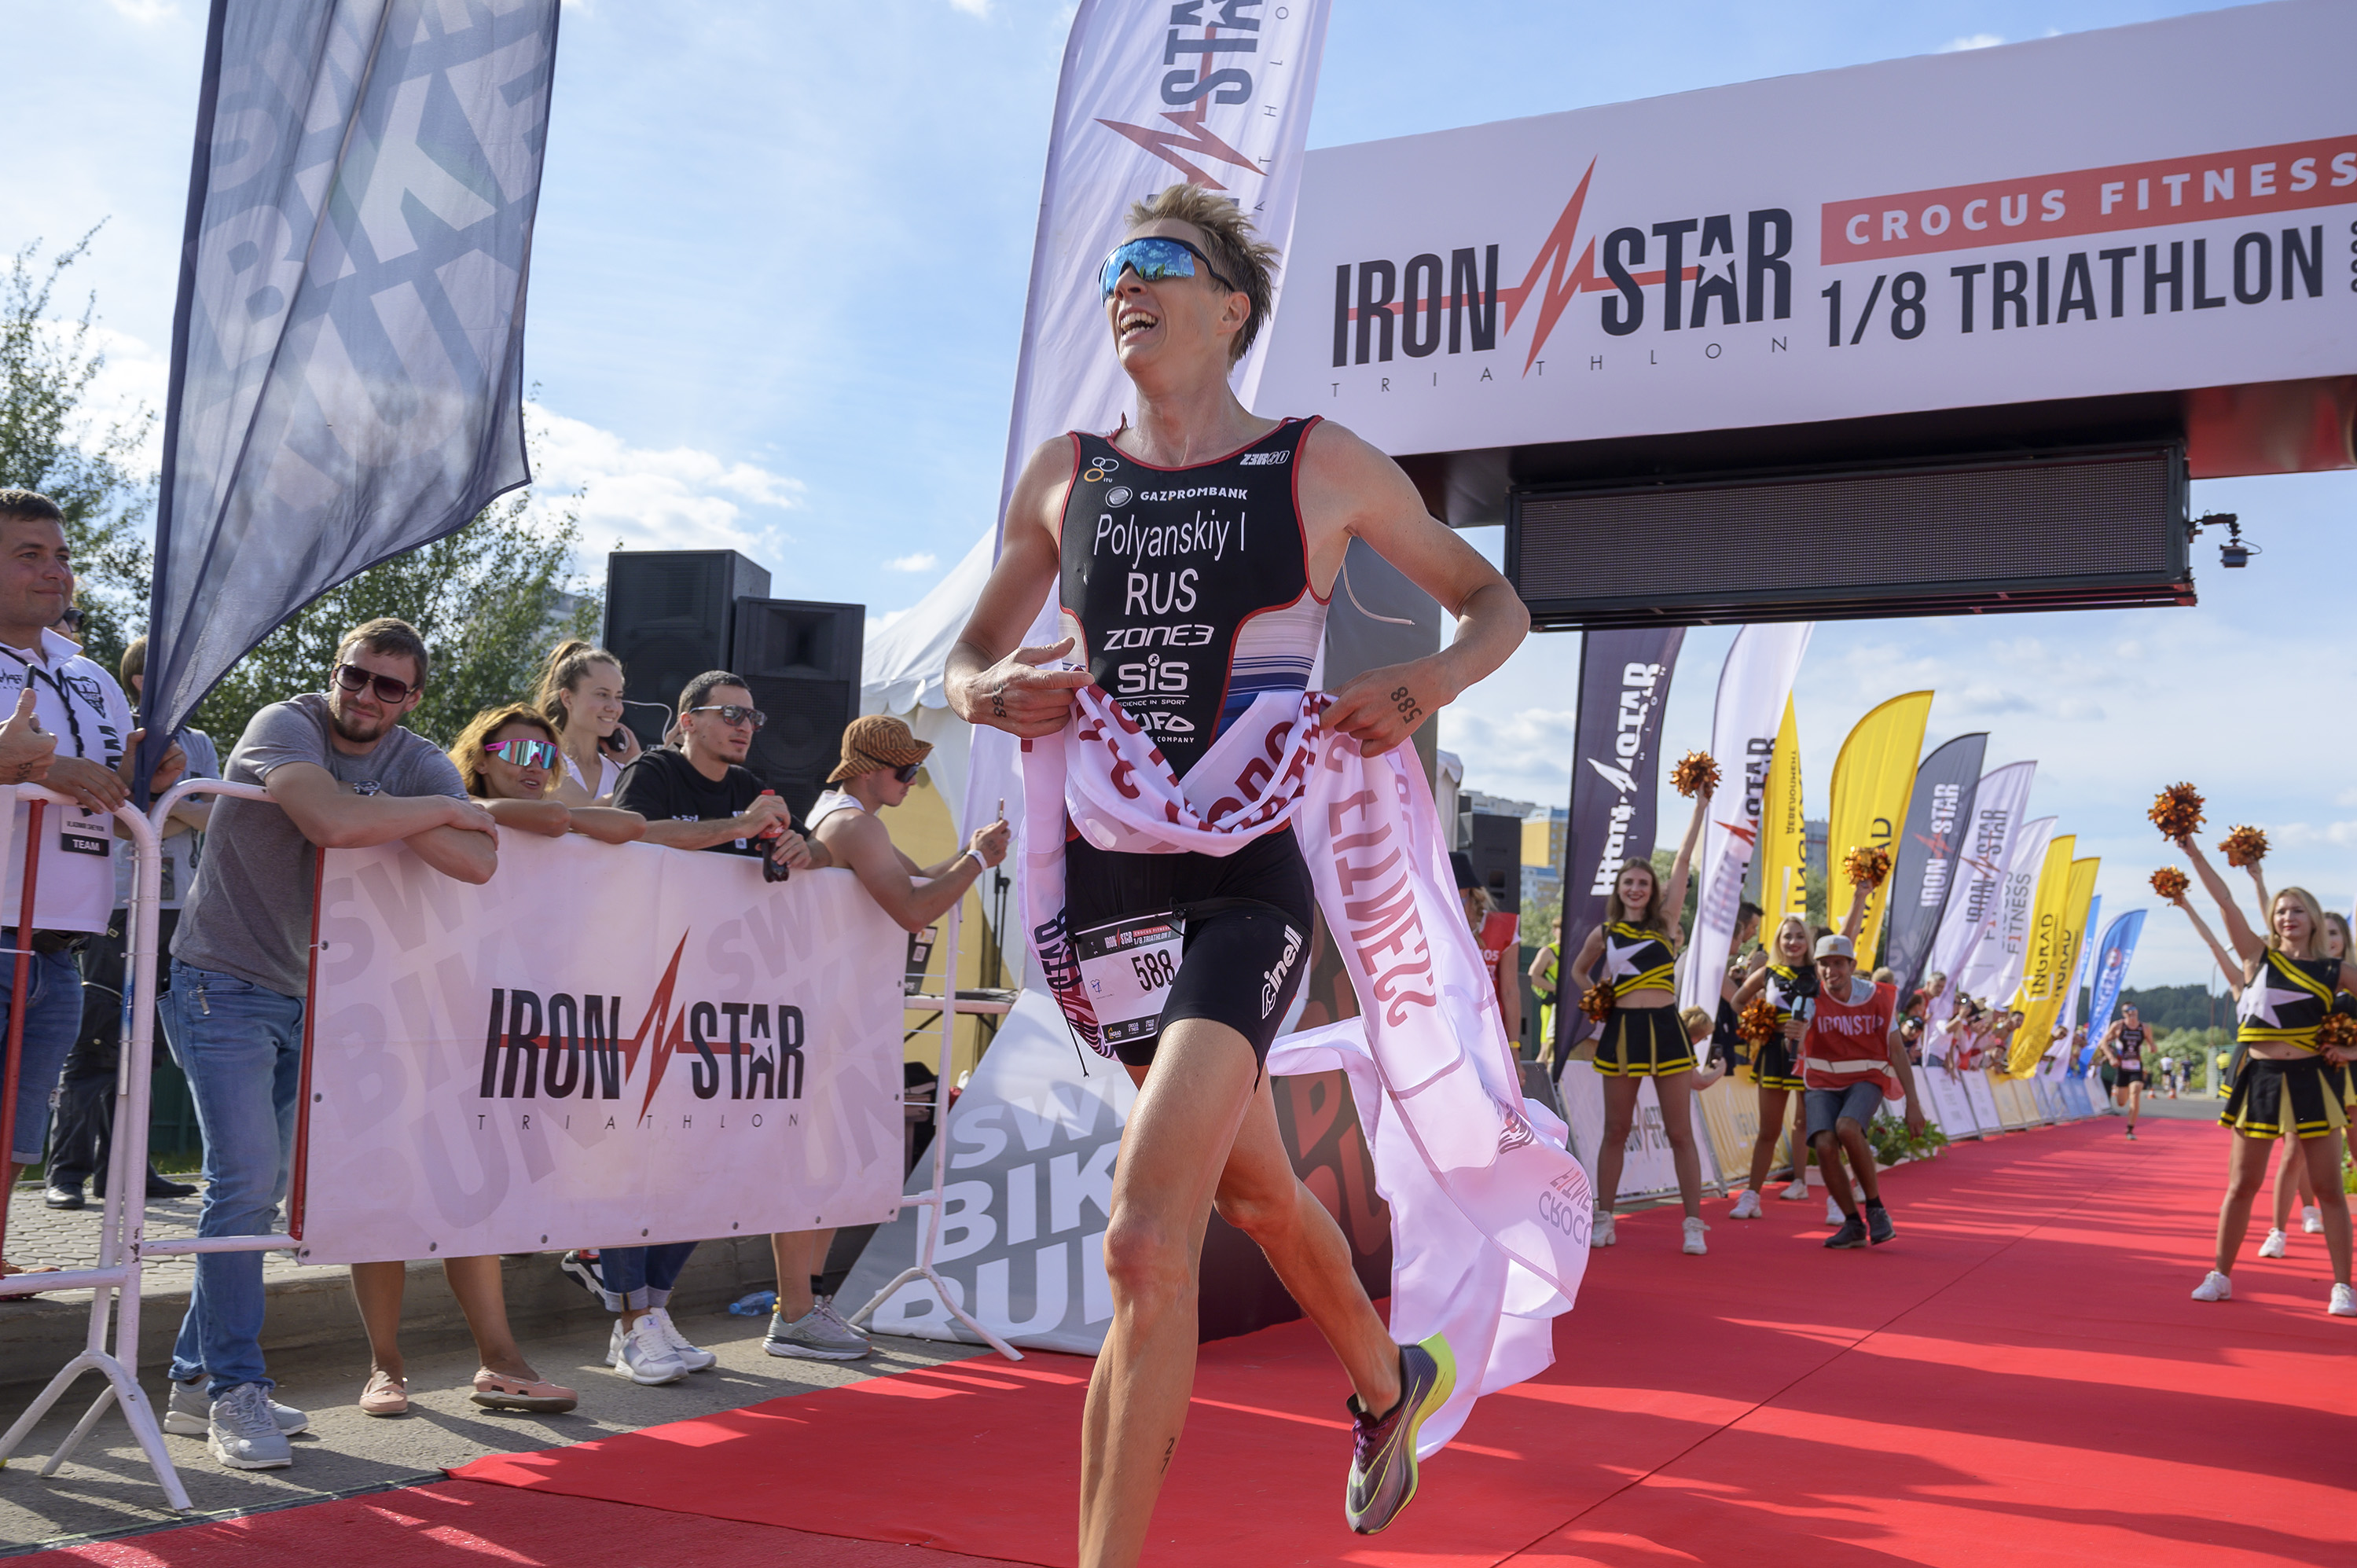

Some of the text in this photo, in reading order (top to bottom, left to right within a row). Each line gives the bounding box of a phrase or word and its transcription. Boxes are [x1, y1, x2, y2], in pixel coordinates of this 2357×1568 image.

[1160, 0, 1261, 105] STA
[1845, 151, 2357, 245] CROCUS FITNESS
[1332, 207, 1793, 368] IRON STAR
[1820, 271, 1927, 347] 1/8
[1950, 224, 2324, 334] TRIATHLON
[1331, 336, 1789, 397] TRIATHLON
[1140, 486, 1249, 502] GAZPROMBANK
[1093, 509, 1231, 570] Polyanskiy
[1125, 568, 1199, 616] RUS
[1390, 686, 1423, 724] 588
[72, 839, 101, 851] TEAM
[1920, 783, 1960, 907] IRON STAR
[1976, 809, 2008, 855] STAR
[1120, 931, 1133, 945] STAR
[1133, 937, 1143, 946] 1/8
[2032, 913, 2054, 996] INGRAD
[1130, 949, 1176, 992] 588
[479, 987, 805, 1100] IRON STAR
[477, 1112, 800, 1131] TRIATHLON
[916, 1138, 1122, 1268] BIK
